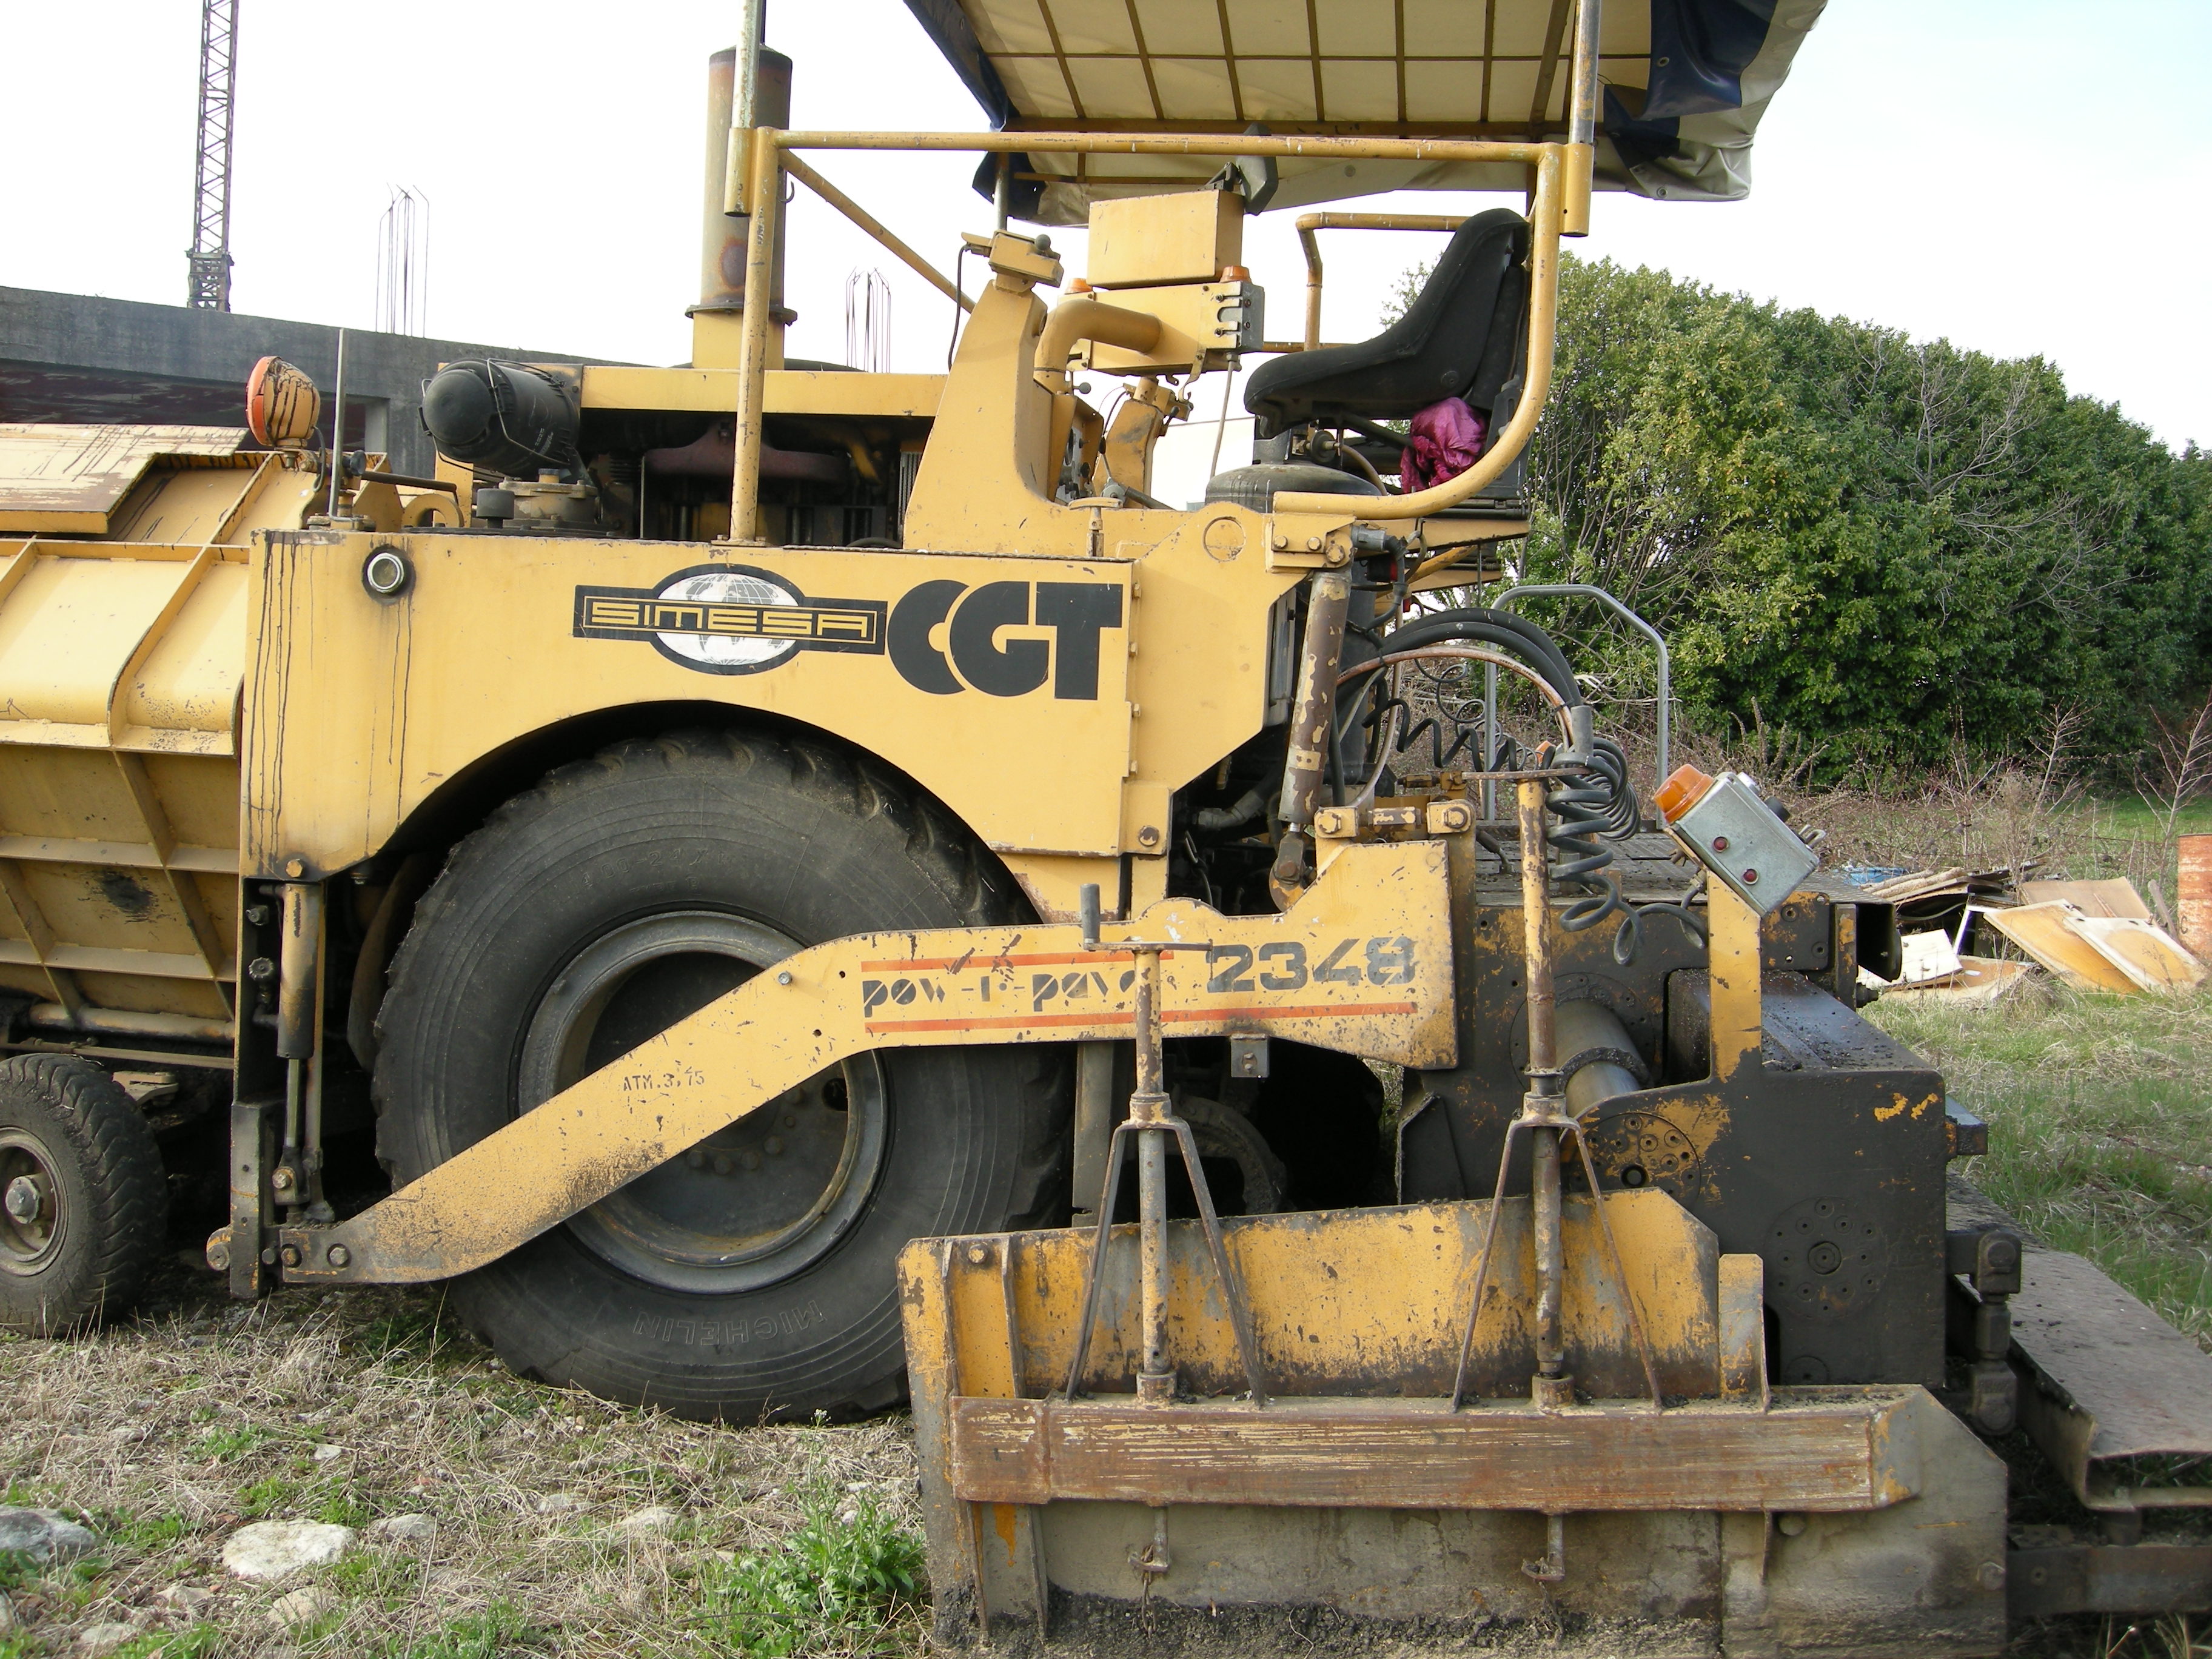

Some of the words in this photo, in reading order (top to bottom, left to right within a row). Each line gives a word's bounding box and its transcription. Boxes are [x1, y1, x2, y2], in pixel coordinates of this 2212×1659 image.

[591, 601, 868, 638] SIMESA
[886, 579, 1123, 700] CGT
[1205, 936, 1416, 993] 2348
[632, 1299, 828, 1346] MICHELIN
